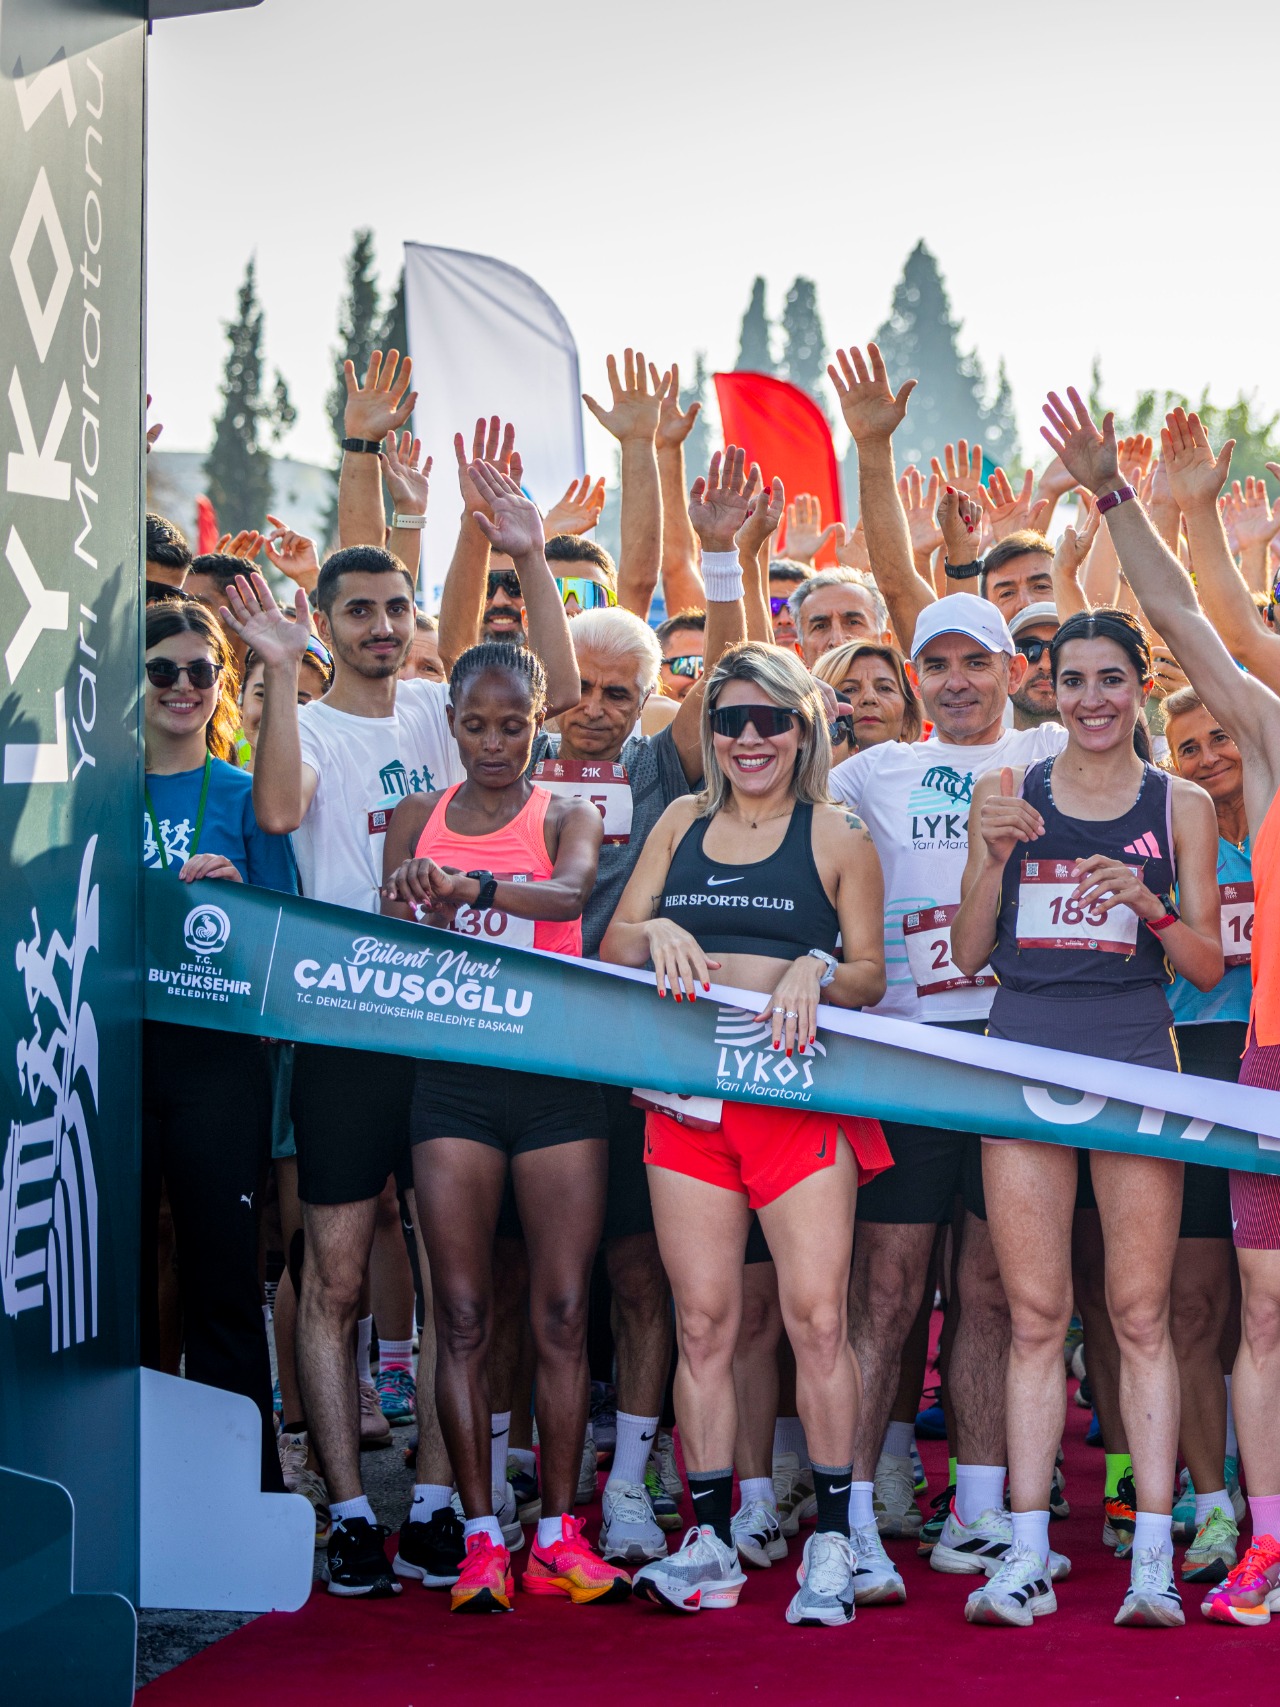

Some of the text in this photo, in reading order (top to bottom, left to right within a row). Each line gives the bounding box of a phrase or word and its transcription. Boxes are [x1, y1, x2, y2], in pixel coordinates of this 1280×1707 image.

[4, 46, 78, 783] LYKOS
[72, 57, 104, 781] Yarı Maratonu
[581, 767, 601, 778] 21K
[665, 894, 794, 911] HER SPORTS CLUB
[1049, 896, 1108, 926] 185
[195, 954, 213, 966] T.C.
[344, 936, 502, 985] Bülent Nuri
[930, 939, 950, 970] 2
[149, 968, 252, 996] BÜYÜKŞEHİR
[293, 959, 533, 1017] ÇAVUŞOĞLU
[297, 993, 524, 1035] T.C. DENİZLİ BÜYÜKŞEHİR BELEDİYE BAŞKANI
[717, 1047, 814, 1089] LYKOS
[716, 1077, 811, 1102] Yarı Maratonu
